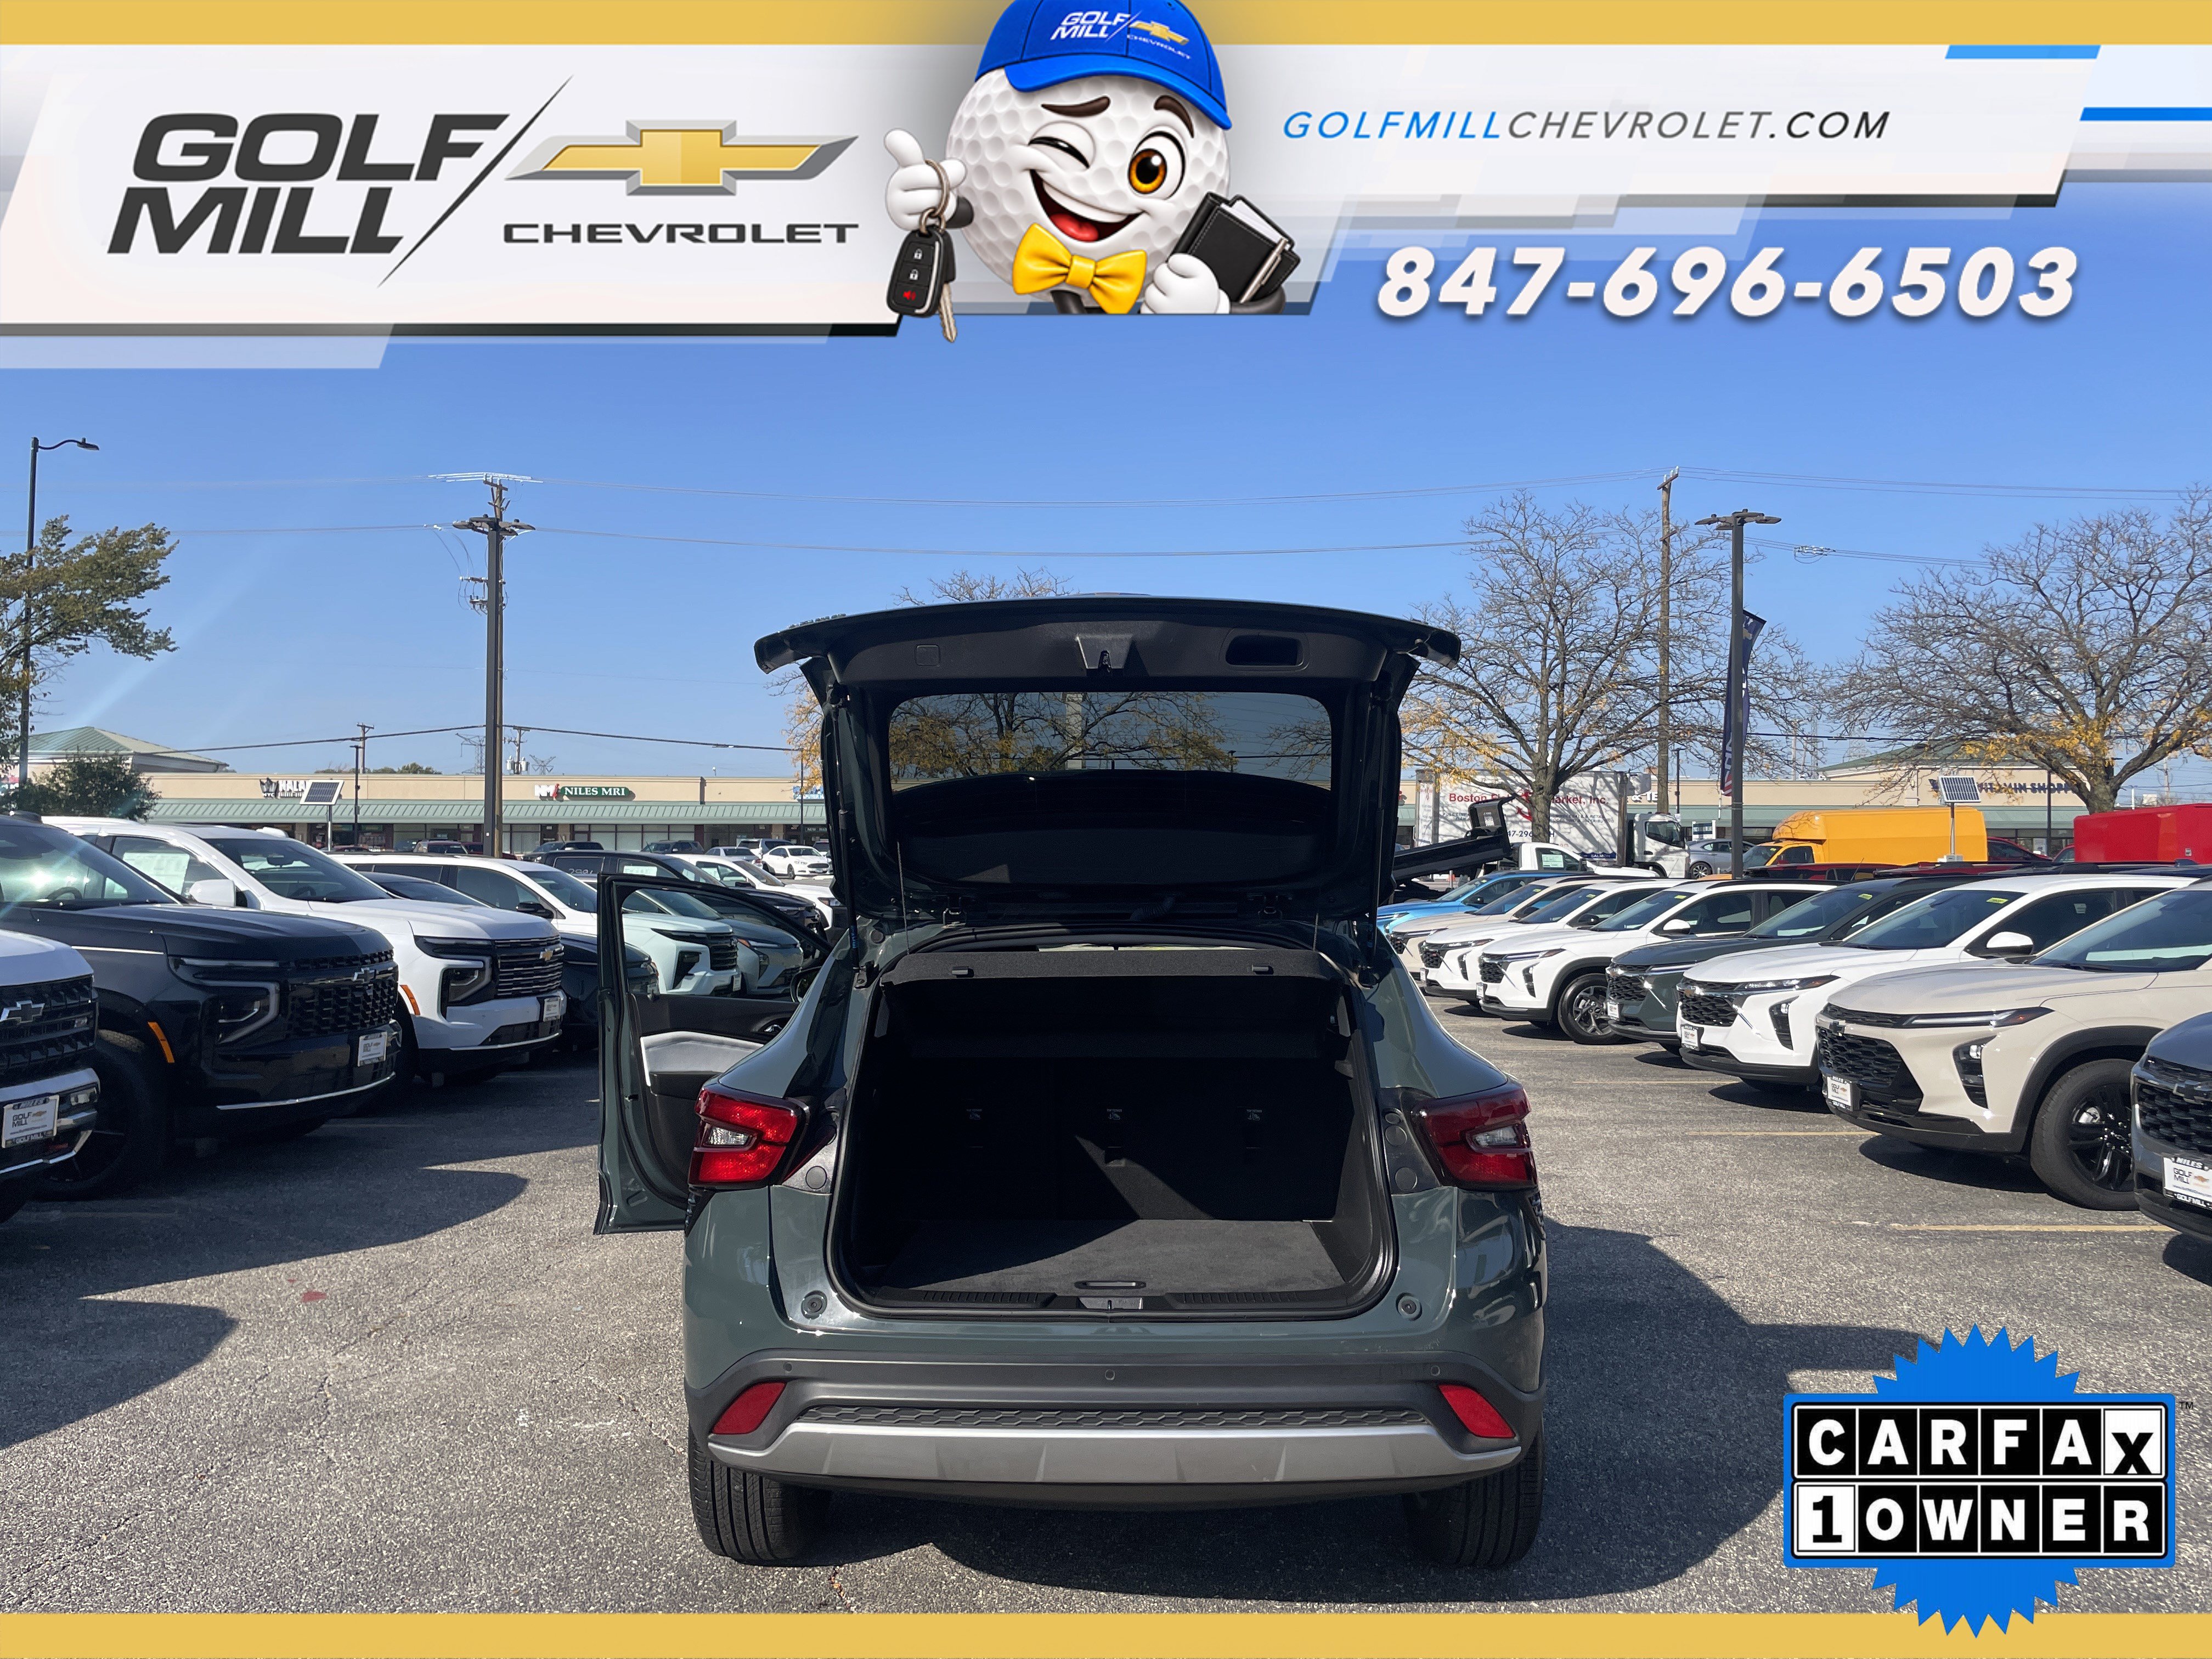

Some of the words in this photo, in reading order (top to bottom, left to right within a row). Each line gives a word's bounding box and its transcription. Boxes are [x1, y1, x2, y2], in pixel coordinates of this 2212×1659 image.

[279, 780, 309, 792] HALA
[565, 787, 598, 795] NILES
[601, 787, 625, 795] MRI
[1449, 793, 1487, 802] Boston
[1550, 795, 1585, 805] arket,
[13, 1111, 32, 1121] GOLF
[12, 1119, 28, 1128] MILL
[2176, 1156, 2203, 1169] NILES
[2173, 1167, 2193, 1178] GOLF
[2174, 1174, 2190, 1184] MILL
